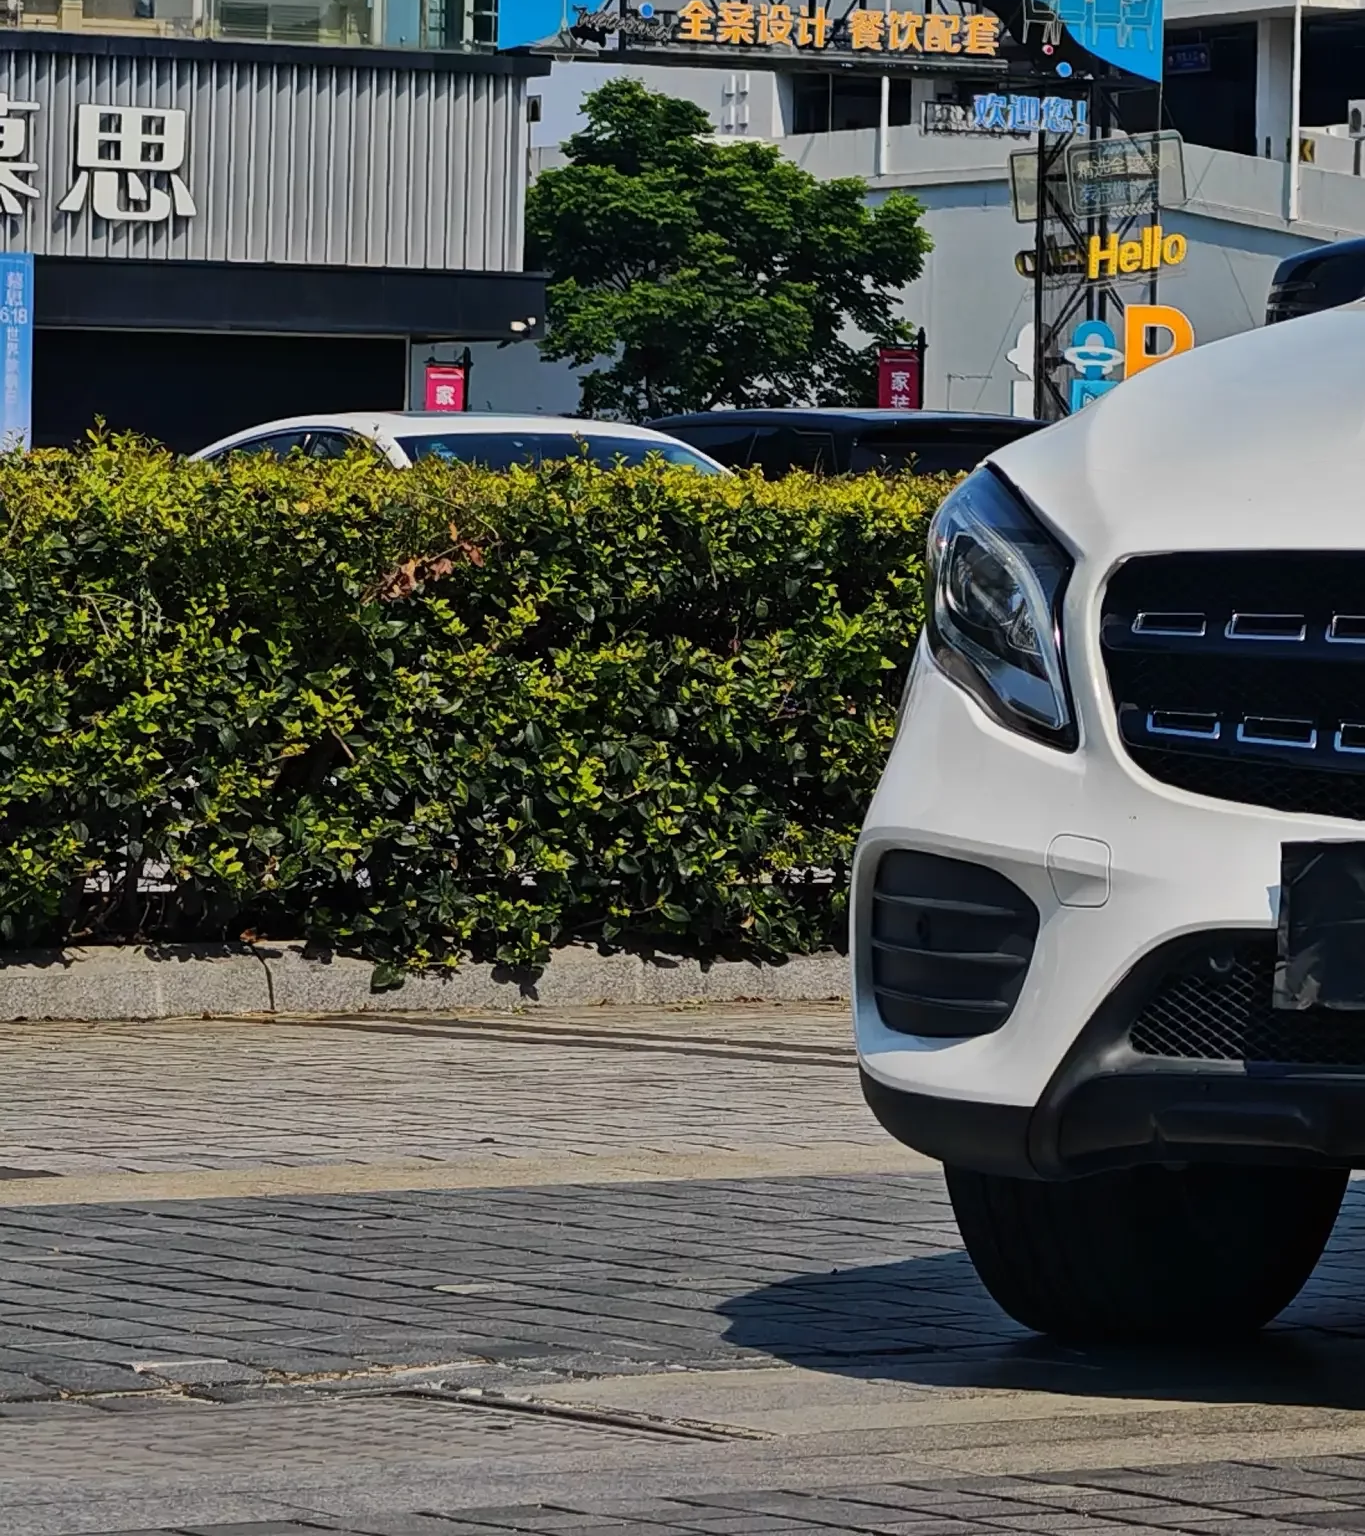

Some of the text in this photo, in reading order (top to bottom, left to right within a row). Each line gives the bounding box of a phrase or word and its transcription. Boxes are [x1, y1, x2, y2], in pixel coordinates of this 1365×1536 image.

[677, 0, 834, 50] 全案设计
[848, 7, 1000, 57] 餐饮配套
[1087, 224, 1188, 280] Hello
